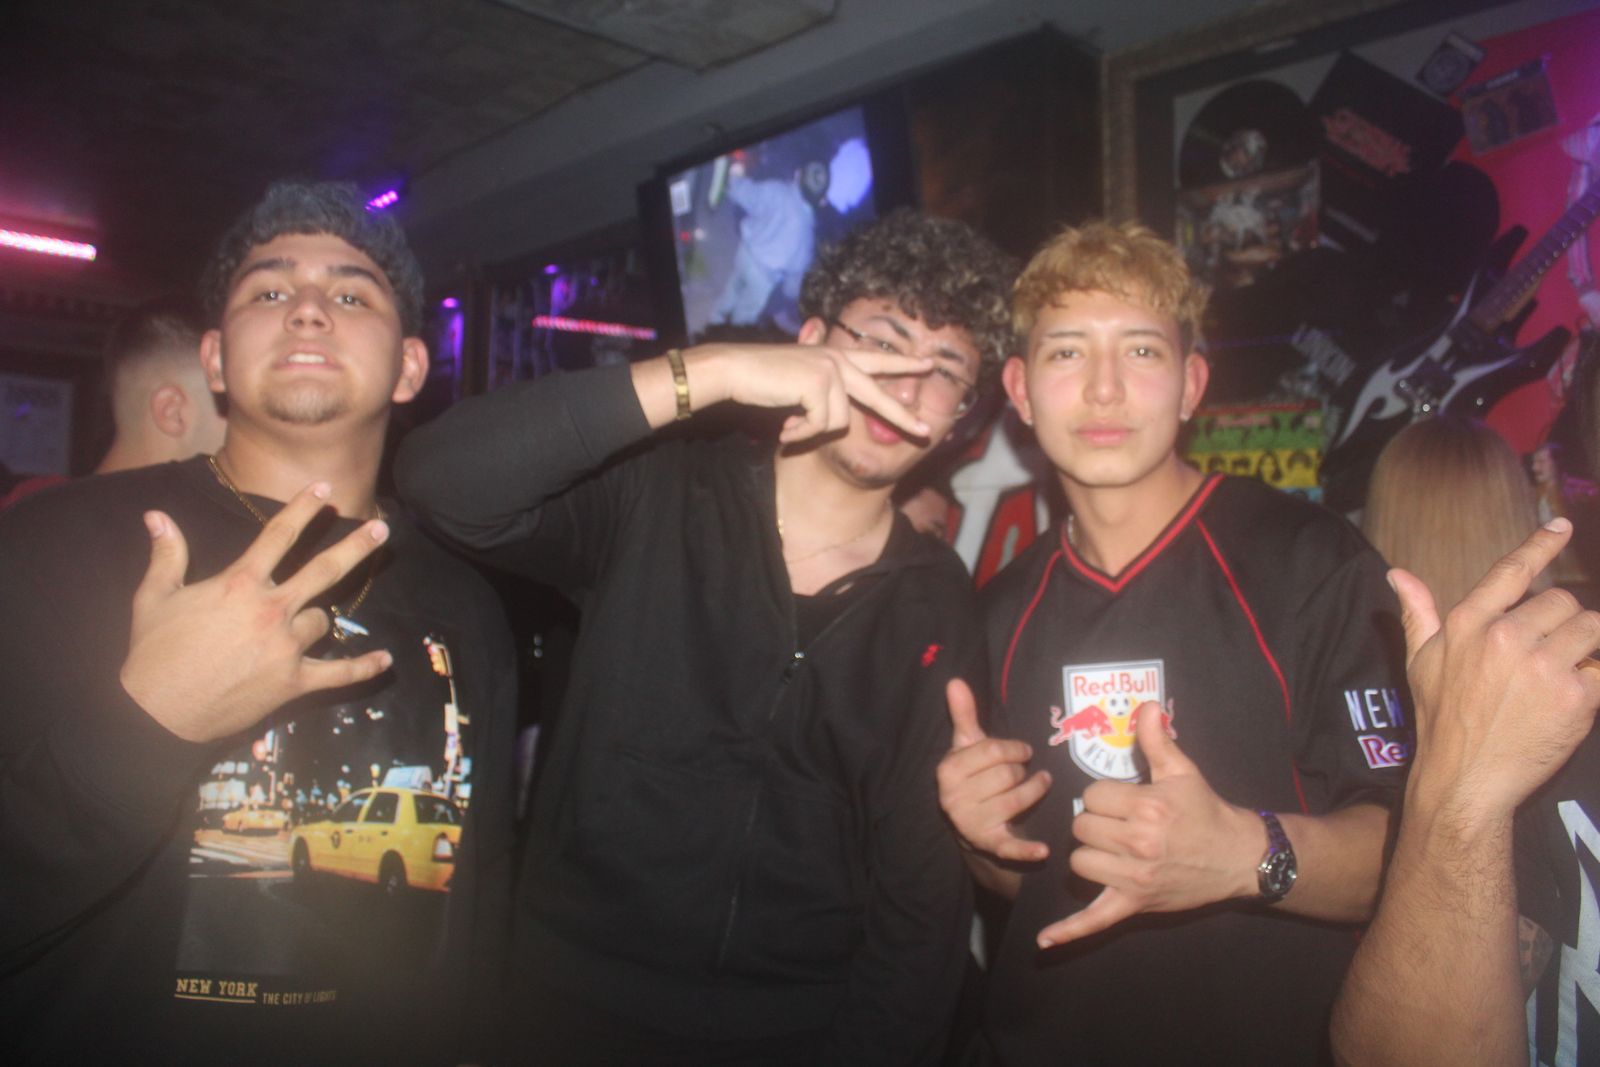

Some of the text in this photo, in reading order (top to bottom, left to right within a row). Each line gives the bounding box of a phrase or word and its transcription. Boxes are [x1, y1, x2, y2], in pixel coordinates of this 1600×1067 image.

[1073, 670, 1157, 697] Red Bull
[1357, 735, 1409, 769] Re
[175, 978, 259, 998] NEW YORK
[263, 991, 281, 1005] THE
[282, 991, 303, 1005] CITY
